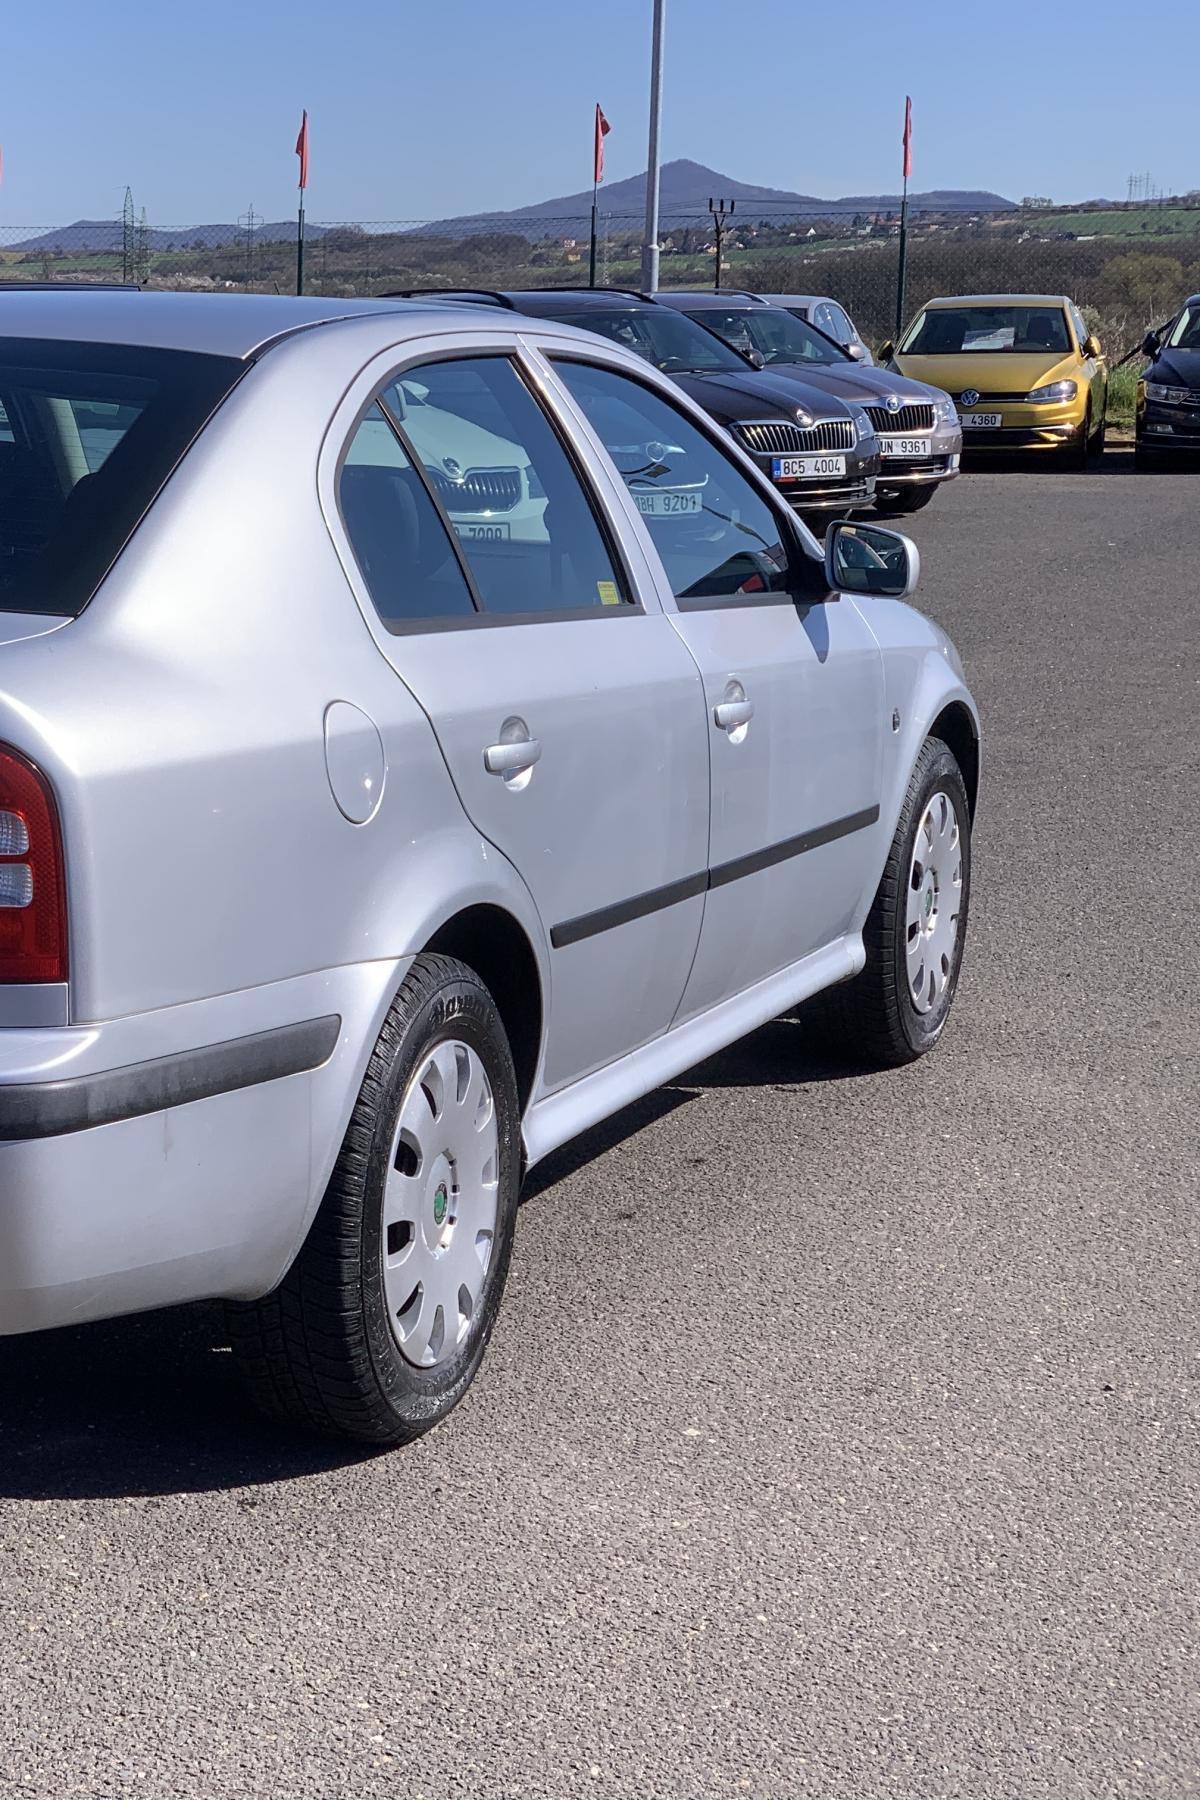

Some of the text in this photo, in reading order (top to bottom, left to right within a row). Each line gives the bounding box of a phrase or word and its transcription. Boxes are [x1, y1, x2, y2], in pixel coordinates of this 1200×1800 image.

[971, 415, 997, 425] 4360
[901, 440, 927, 453] 9361
[783, 457, 841, 475] 8C5 4004
